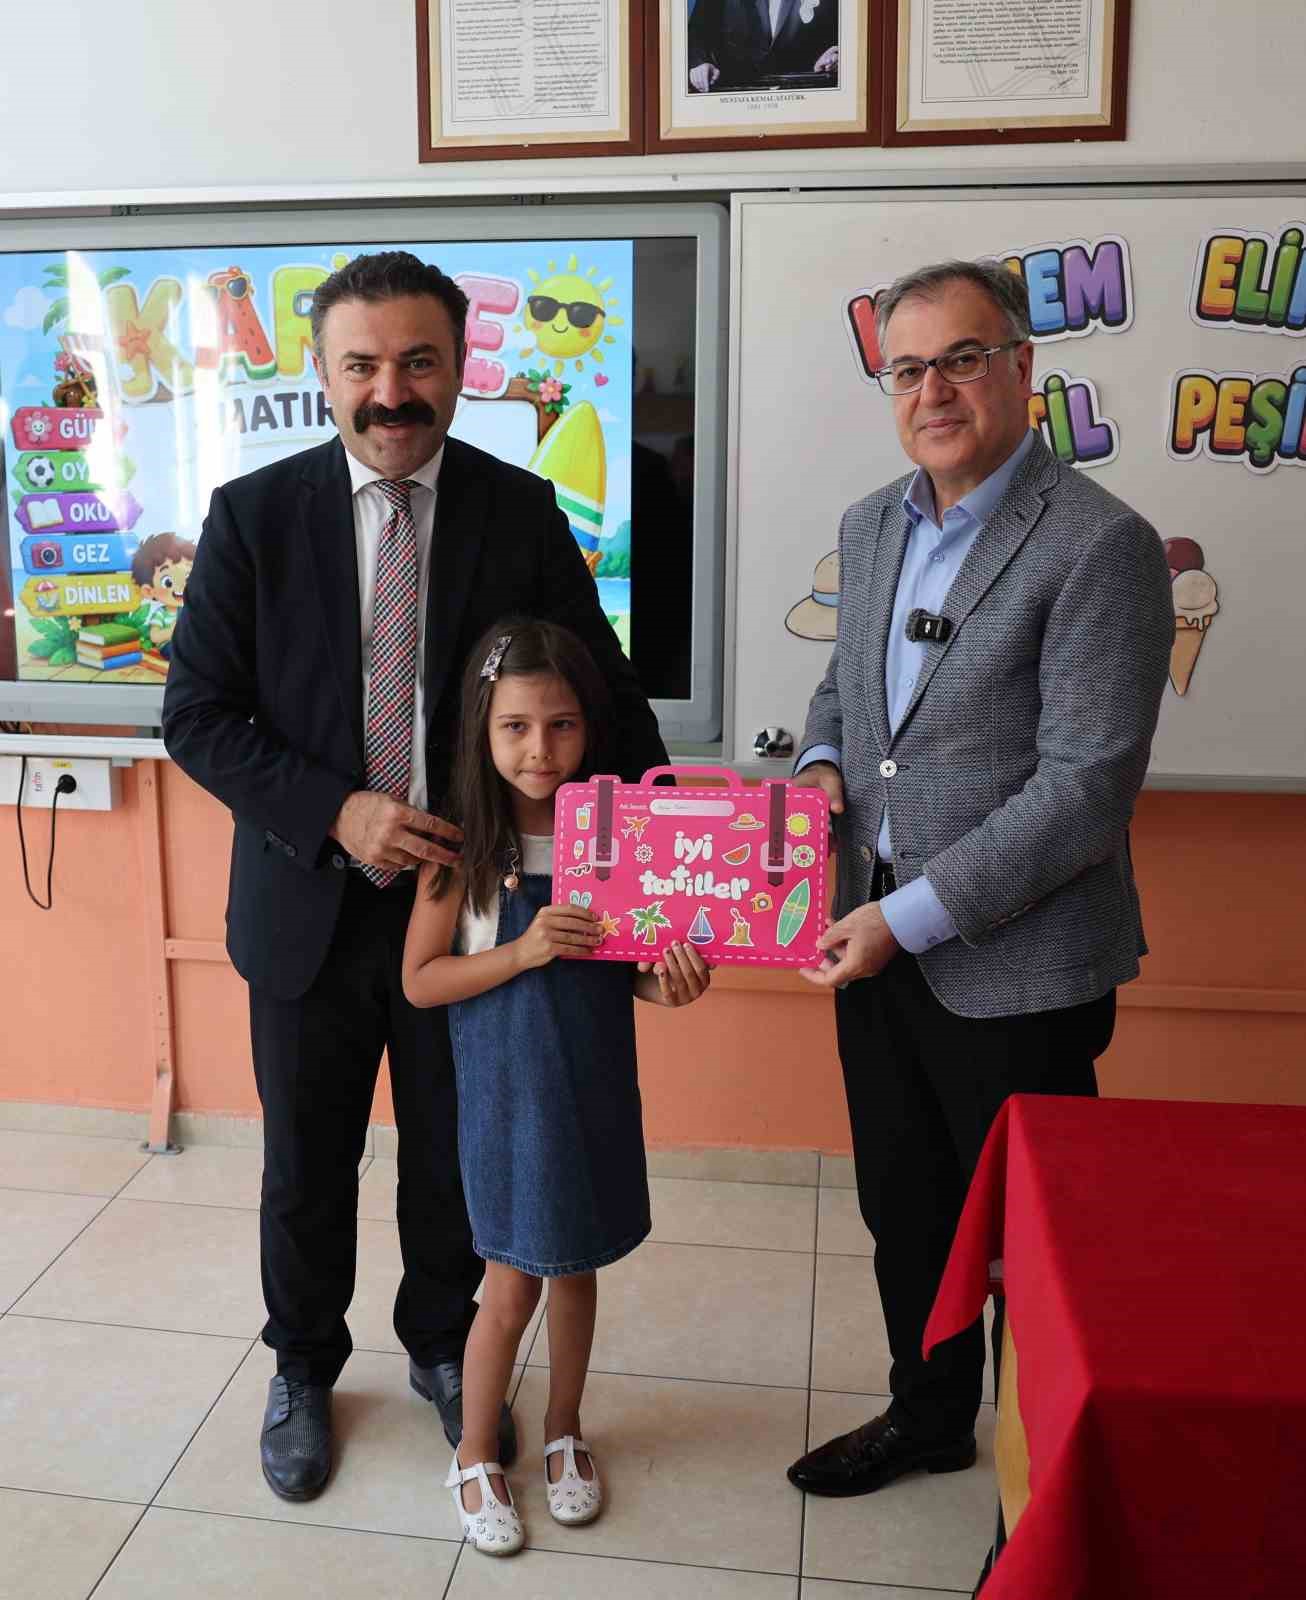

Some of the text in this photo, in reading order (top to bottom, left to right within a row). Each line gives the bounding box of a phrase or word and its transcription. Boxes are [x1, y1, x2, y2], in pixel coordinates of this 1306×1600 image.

[104, 265, 519, 398] KARE
[1172, 366, 1306, 468] PEŞİ
[70, 502, 110, 523] OKU
[72, 543, 110, 564] GEZ
[64, 580, 130, 605] DİNLEN
[674, 831, 713, 864] iyi
[639, 864, 750, 901] tatiller
